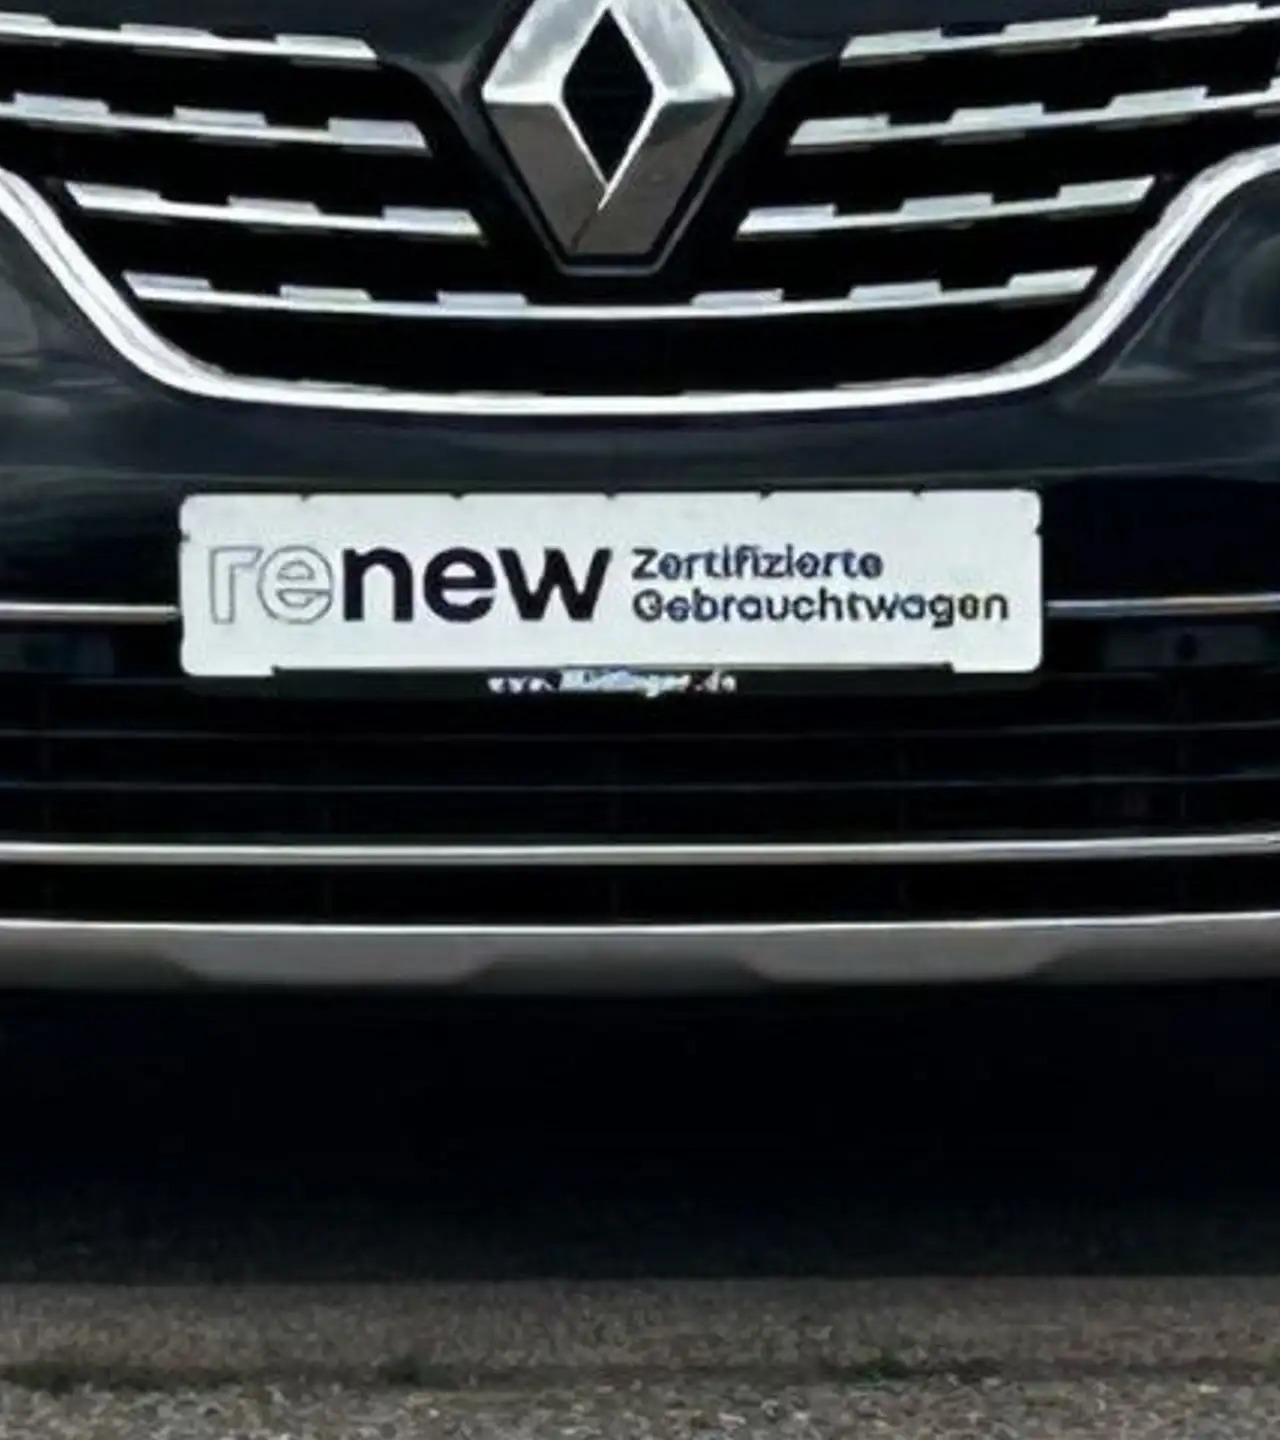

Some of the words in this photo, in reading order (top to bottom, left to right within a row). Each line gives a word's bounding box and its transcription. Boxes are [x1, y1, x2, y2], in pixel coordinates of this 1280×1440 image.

[630, 543, 884, 581] Zertifizierte
[208, 545, 613, 624] renew
[631, 586, 1010, 629] Gebrauchtwagen
